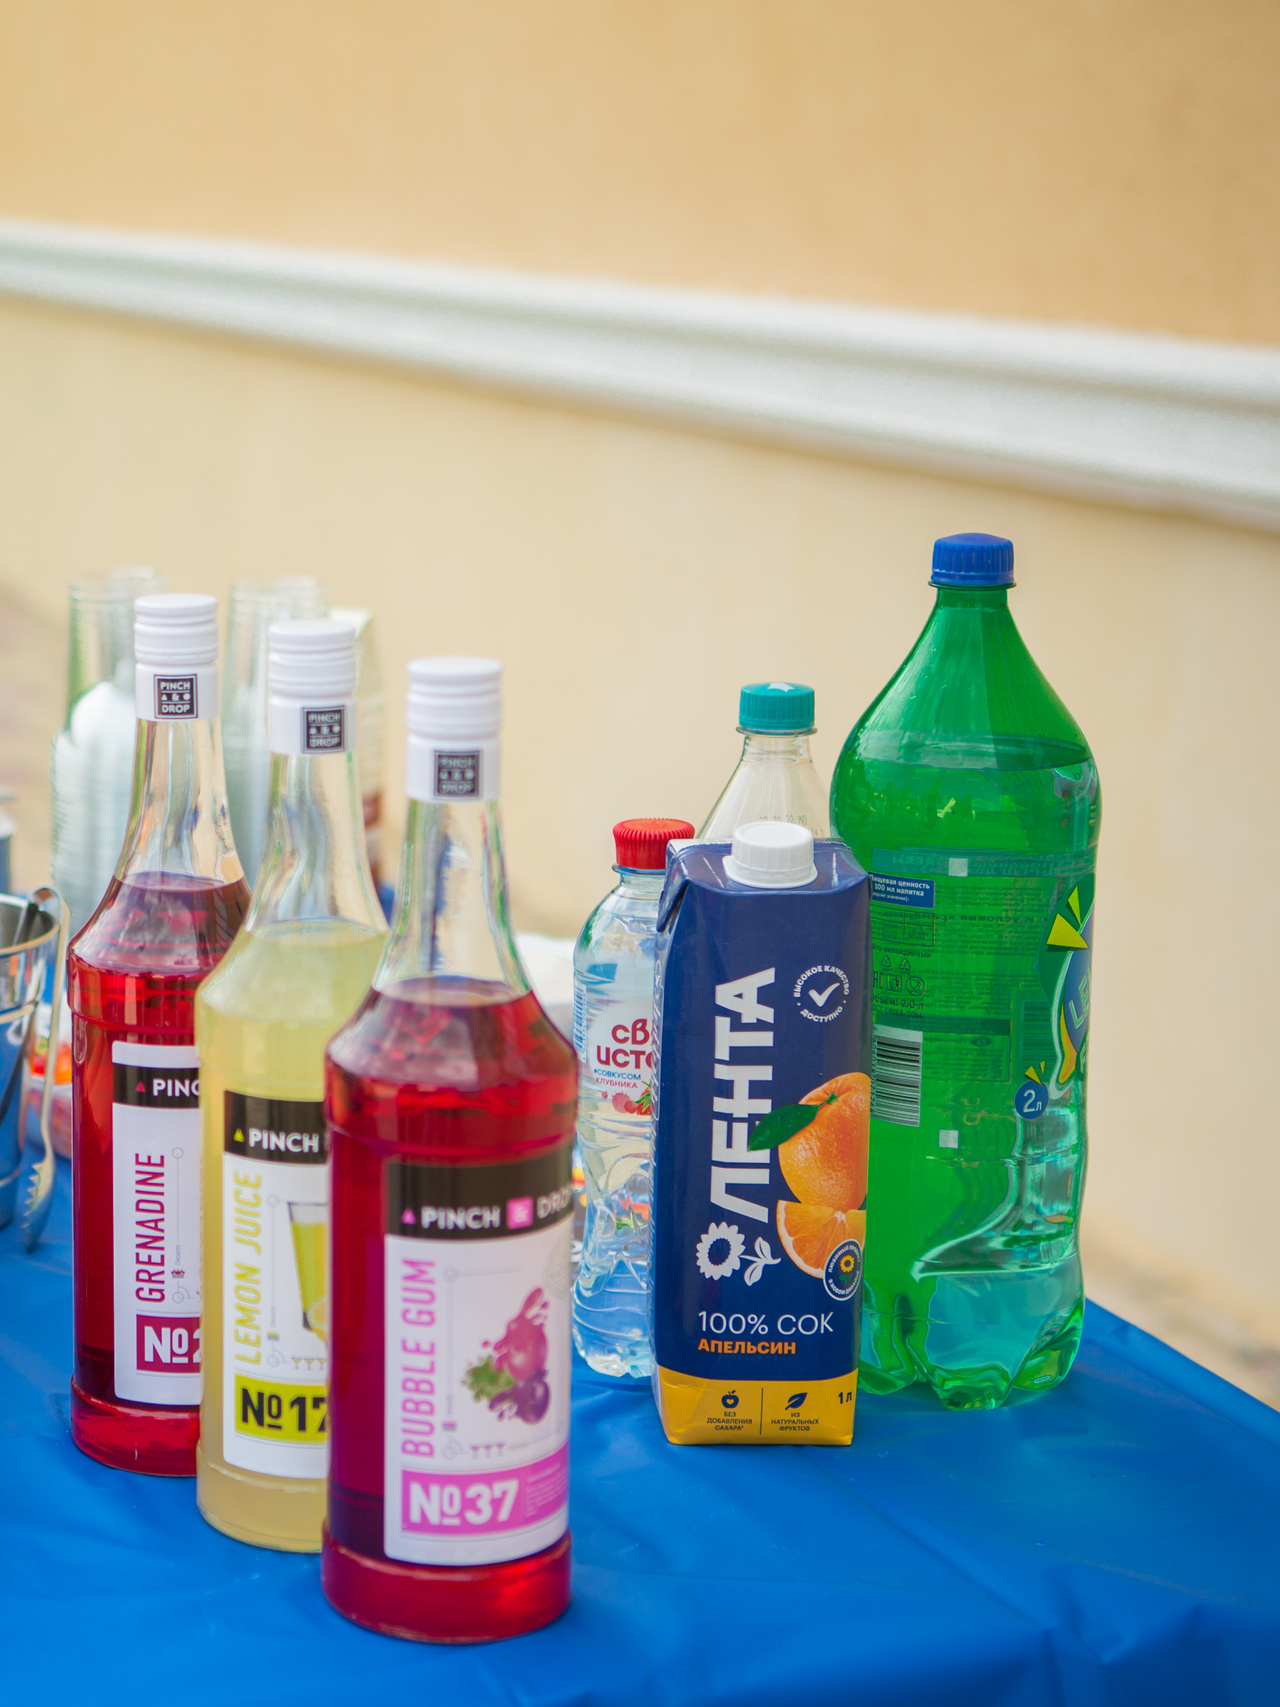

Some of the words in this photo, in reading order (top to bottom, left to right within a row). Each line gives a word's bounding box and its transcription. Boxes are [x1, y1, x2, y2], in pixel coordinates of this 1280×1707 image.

[160, 681, 191, 690] PINCH
[171, 693, 180, 702] &
[161, 704, 191, 714] DROP
[793, 965, 823, 998] ВЫСОКОЕ
[823, 965, 850, 996] КАЧЕСТВО
[800, 1006, 843, 1023] ДОСТУПНО
[595, 1077, 638, 1089] КЛУБНИКА
[710, 967, 776, 1224] ЛЕНТА
[247, 1127, 320, 1154] PINCH
[233, 1169, 262, 1256] JUICE
[420, 1205, 502, 1231] PINCH
[135, 1152, 166, 1304] GRENADINE
[401, 1258, 436, 1328] GUM
[233, 1263, 262, 1366] LEMON
[698, 1310, 769, 1335] 100%
[776, 1311, 834, 1336] СОК
[697, 1338, 797, 1355] АПЕЛЬСИН
[401, 1338, 436, 1459] BUBBLE
[706, 1417, 753, 1425] ДОБАВЛЕНИЯ
